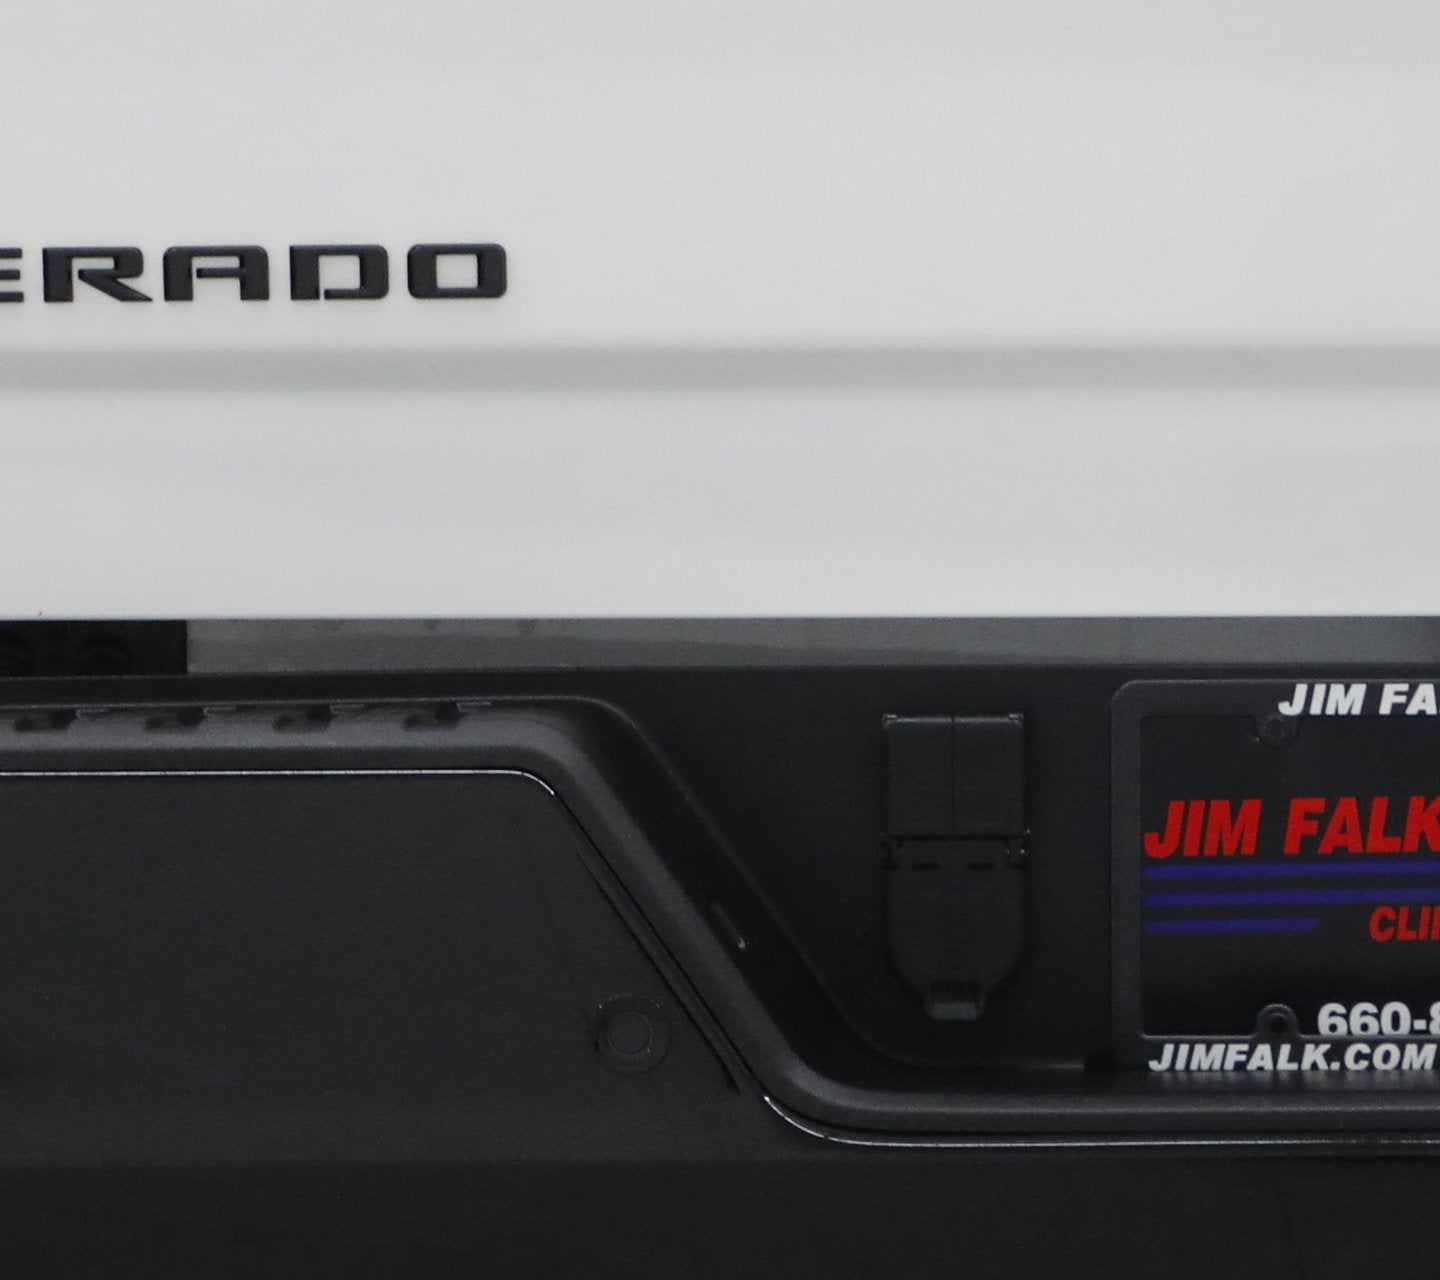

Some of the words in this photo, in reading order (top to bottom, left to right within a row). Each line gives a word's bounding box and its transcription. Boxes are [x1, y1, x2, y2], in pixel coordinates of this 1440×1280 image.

[1277, 682, 1367, 717] JIM
[1142, 797, 1264, 860] JIM
[1147, 1042, 1438, 1073] JIMFALK.COM
